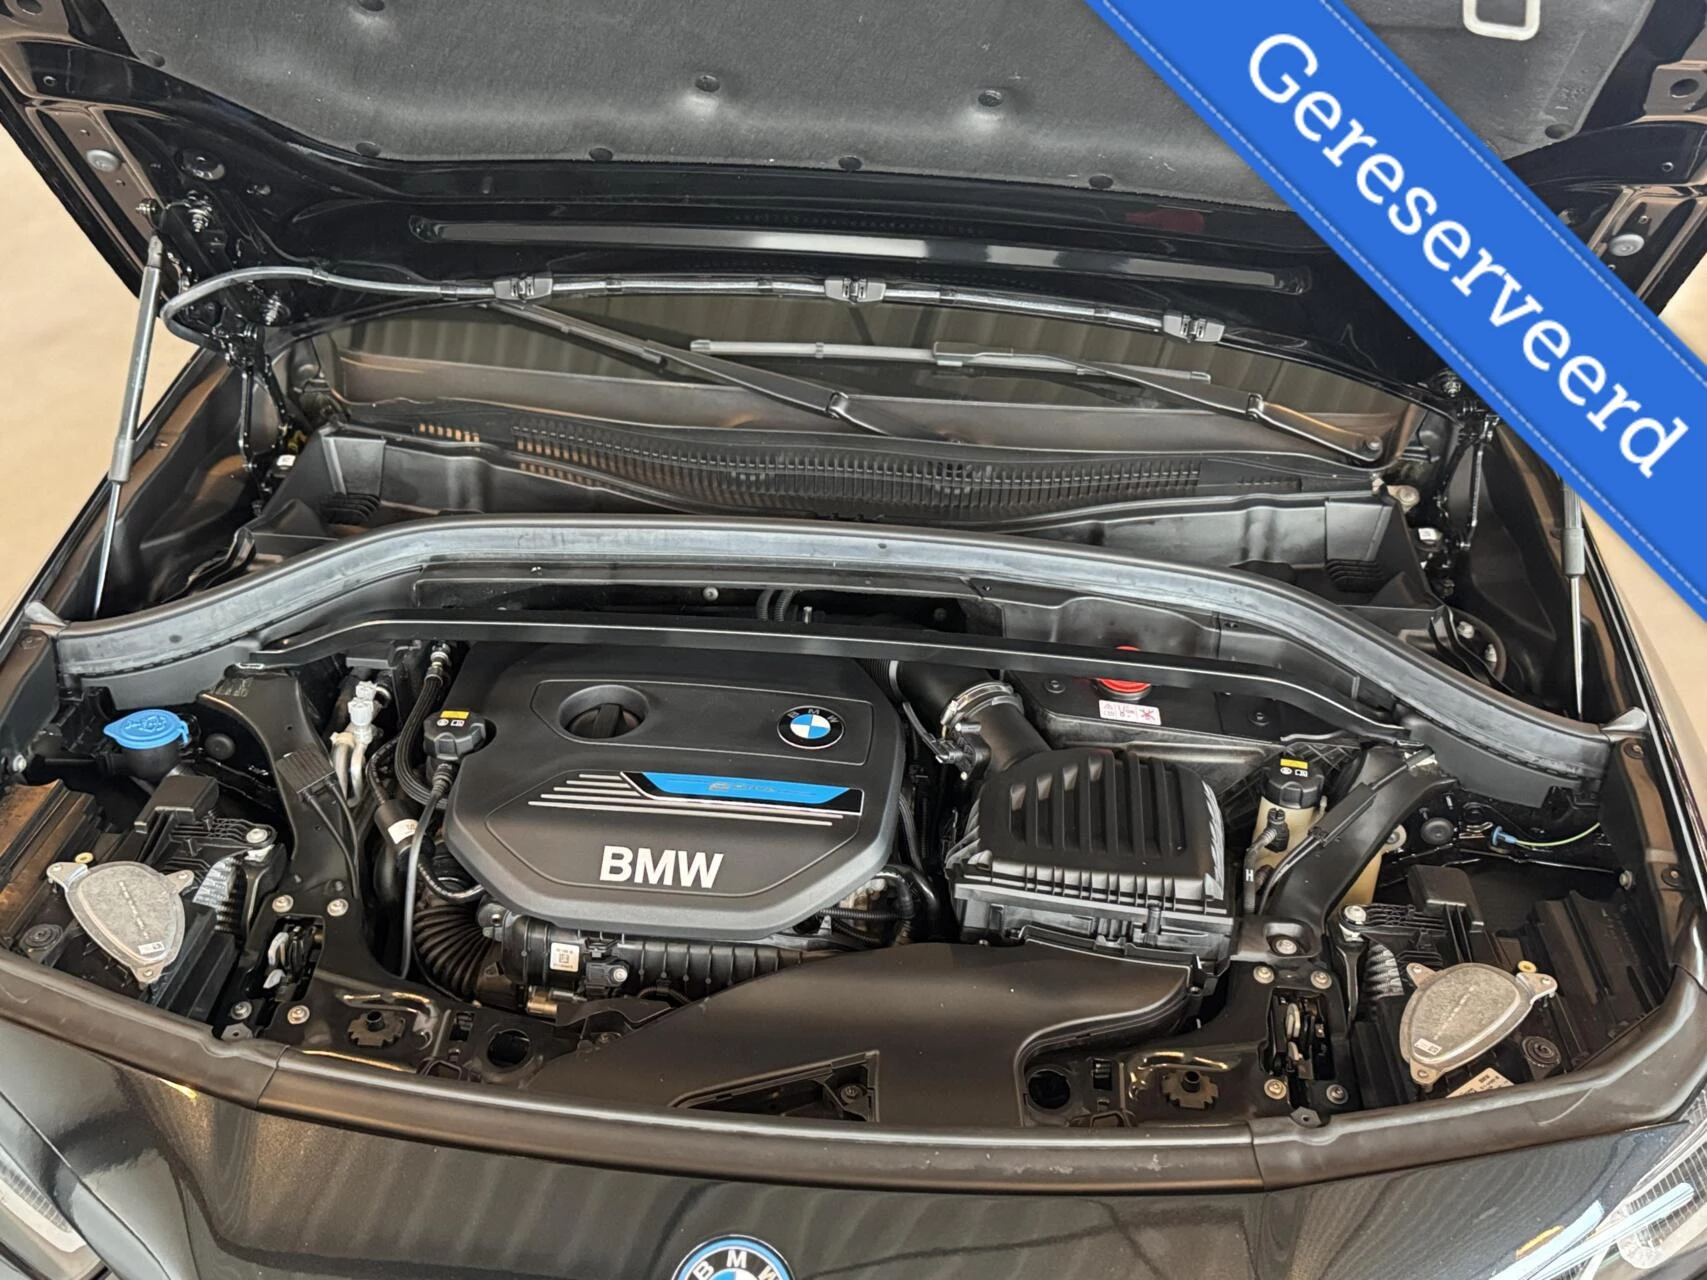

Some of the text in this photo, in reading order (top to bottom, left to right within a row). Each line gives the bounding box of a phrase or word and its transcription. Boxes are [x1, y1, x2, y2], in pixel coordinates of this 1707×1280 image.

[787, 709, 839, 723] BMW
[600, 845, 724, 889] BMW
[692, 1249, 778, 1280] BMW
